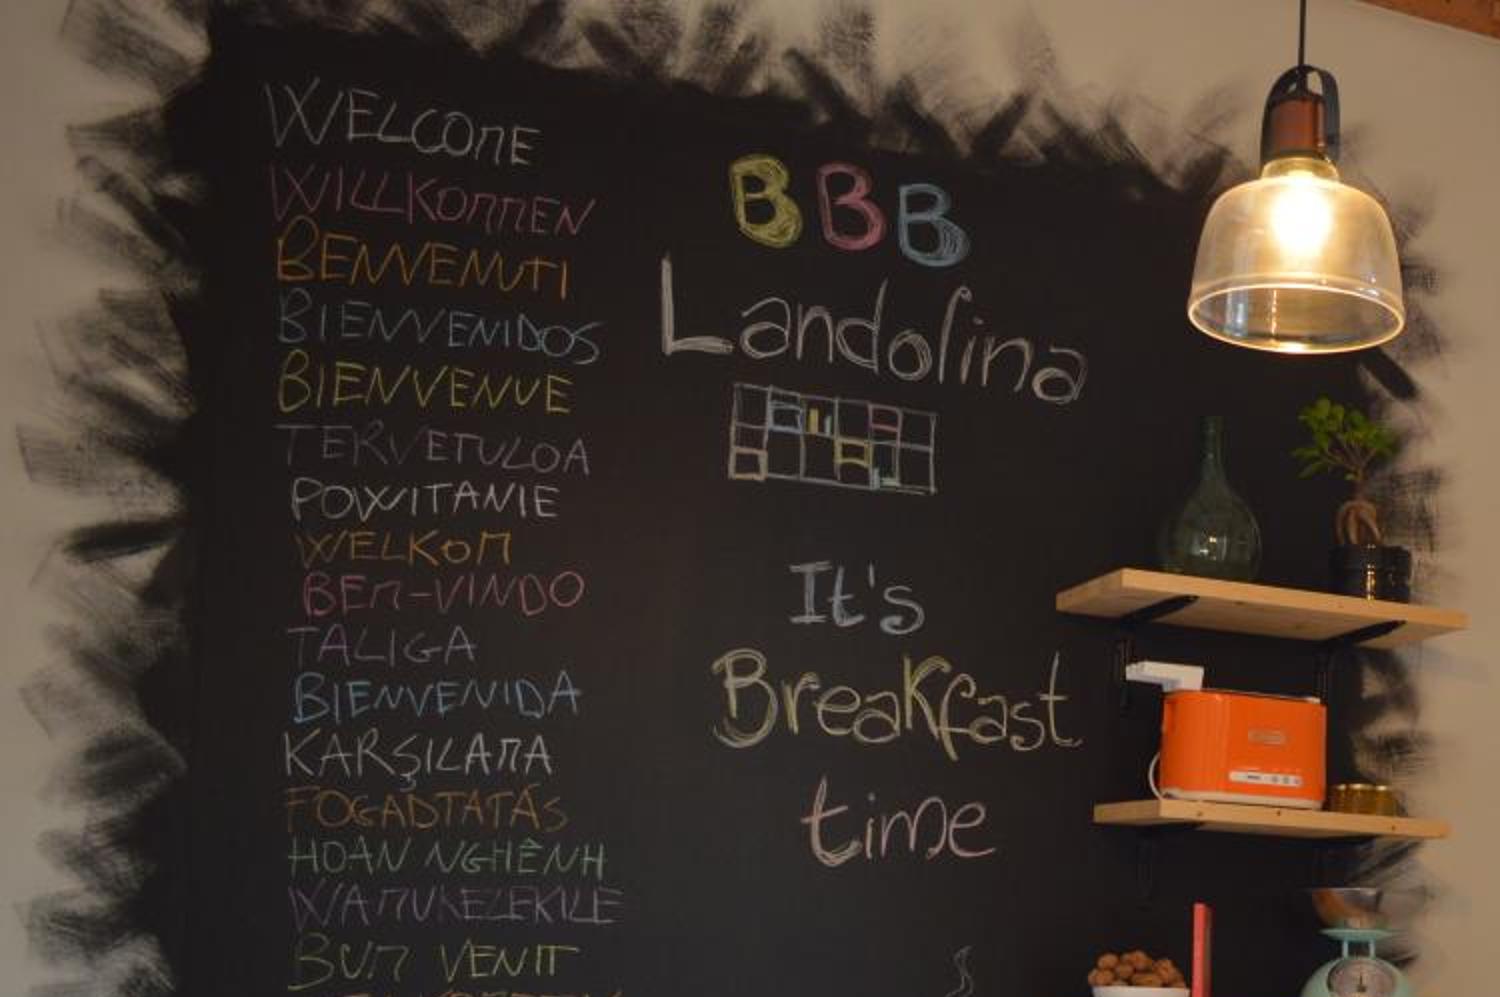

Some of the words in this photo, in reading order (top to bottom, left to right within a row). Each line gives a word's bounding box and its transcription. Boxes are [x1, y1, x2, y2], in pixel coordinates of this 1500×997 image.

[263, 77, 541, 165] WELCOME
[268, 163, 597, 236] WILLKOMMEN
[276, 215, 568, 300] BENVENUTI
[277, 288, 602, 364] BIENVENIDOS
[661, 252, 1088, 405] Landolina
[278, 349, 574, 413] BIENVENUE
[273, 418, 591, 476] TERVETULOA
[290, 476, 561, 521] POWITANIE
[296, 529, 512, 567] WELKOM
[303, 570, 585, 617] BEM-VINDO
[789, 560, 926, 635] It's
[293, 669, 584, 725] BIENVENIDA
[800, 774, 997, 867] time
[440, 938, 581, 984] VENIT
